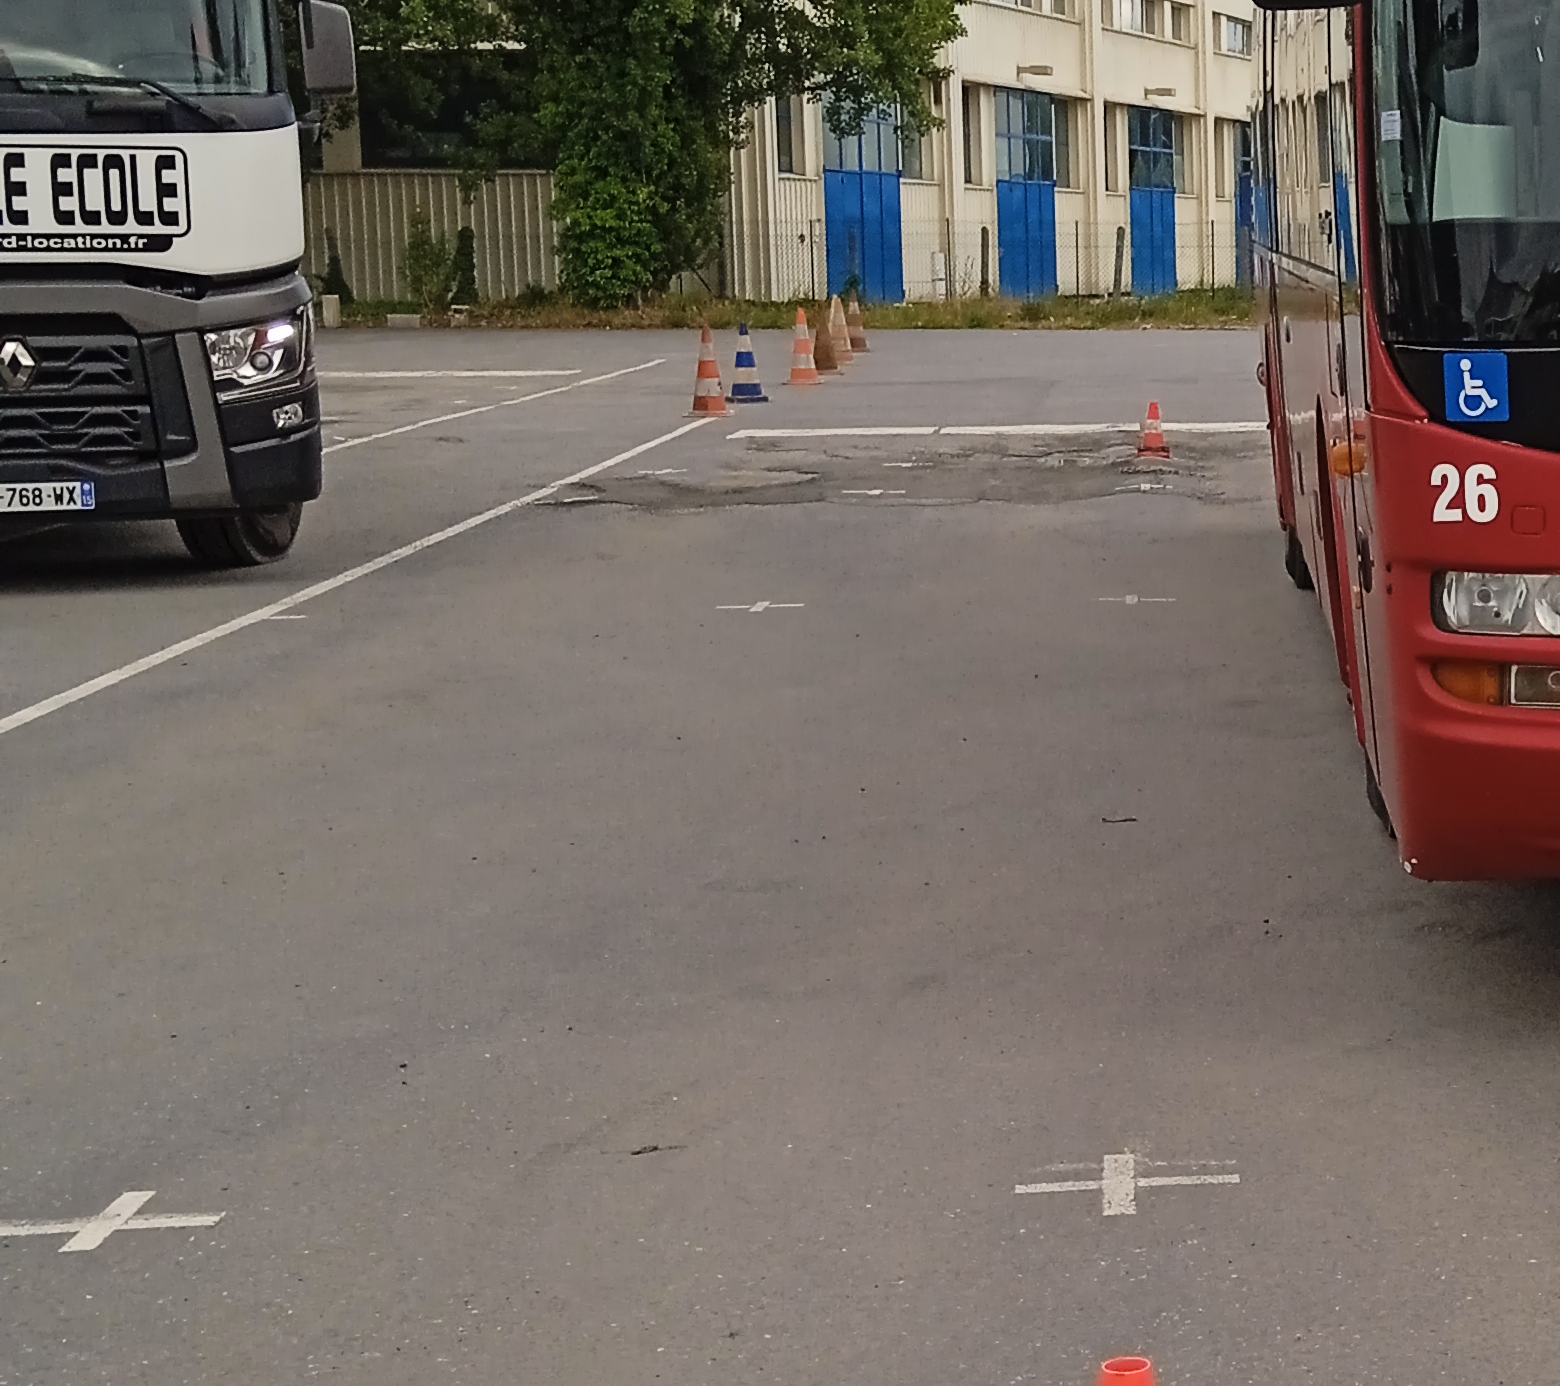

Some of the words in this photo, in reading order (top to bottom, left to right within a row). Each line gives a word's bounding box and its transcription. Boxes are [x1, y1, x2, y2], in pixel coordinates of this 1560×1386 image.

[0, 152, 30, 226] E
[51, 153, 179, 226] ECOLE
[0, 235, 148, 249] d-location.fr
[1431, 463, 1499, 523] 26
